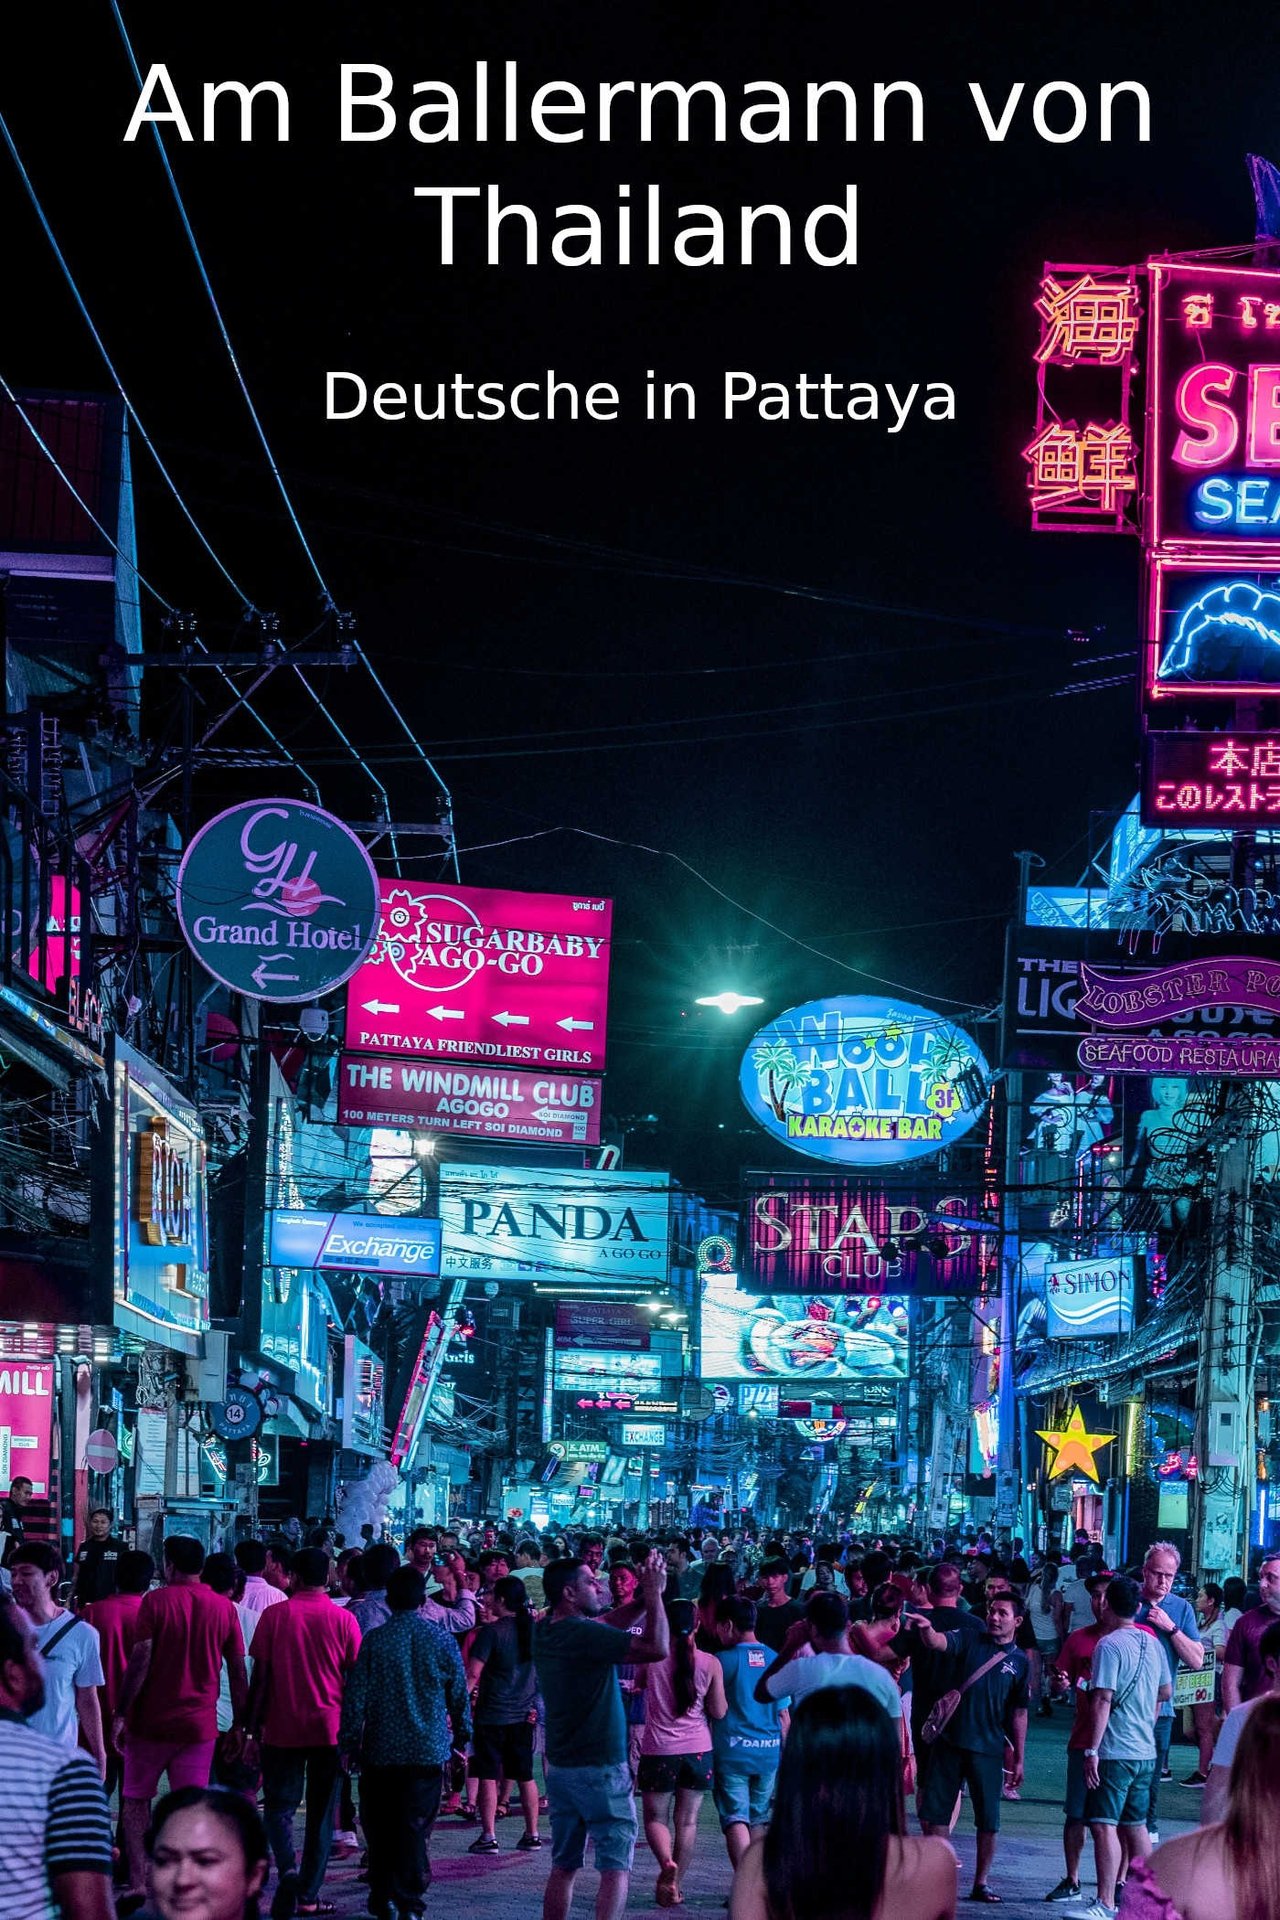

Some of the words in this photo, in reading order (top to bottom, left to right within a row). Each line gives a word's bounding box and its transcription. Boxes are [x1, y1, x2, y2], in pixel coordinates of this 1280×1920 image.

[1211, 740, 1280, 776] 本店
[193, 916, 279, 946] Grand
[286, 920, 363, 951] Hotel
[426, 922, 606, 959] SUGARBABY
[418, 945, 544, 976] AGO-GO
[1017, 957, 1078, 974] THE
[1084, 969, 1231, 1014] LOBSTER
[360, 1032, 434, 1051] PATTAYA
[437, 1039, 541, 1060] FRIENDLIEST
[543, 1048, 592, 1063] GIRLS
[1085, 1044, 1173, 1063] SEAFOOD
[347, 1063, 393, 1089] THE
[402, 1067, 525, 1102] WINDMILL
[533, 1081, 594, 1108] CLUB
[800, 1068, 931, 1116] BALL
[934, 1089, 954, 1109] 3F
[437, 1097, 509, 1118] AGOGO
[552, 1113, 585, 1121] DIAMOND
[343, 1110, 364, 1120] 100
[366, 1111, 414, 1125] METERS
[417, 1115, 450, 1127] TURN
[453, 1119, 482, 1131] LEFT
[485, 1121, 505, 1133] SOI
[508, 1123, 563, 1138] DIAMOND
[787, 1114, 897, 1138] KARAOKE
[897, 1115, 943, 1140] BAR
[460, 1199, 650, 1243] PANDA
[754, 1191, 972, 1260] STARS
[325, 1234, 434, 1264] Exchange
[445, 1256, 493, 1270] 中文服务
[600, 1248, 608, 1258] A
[612, 1248, 635, 1259] GO
[638, 1249, 662, 1260] GO
[823, 1255, 903, 1278] CLUB
[1064, 1269, 1131, 1295] SIMON
[229, 1408, 241, 1419] 14
